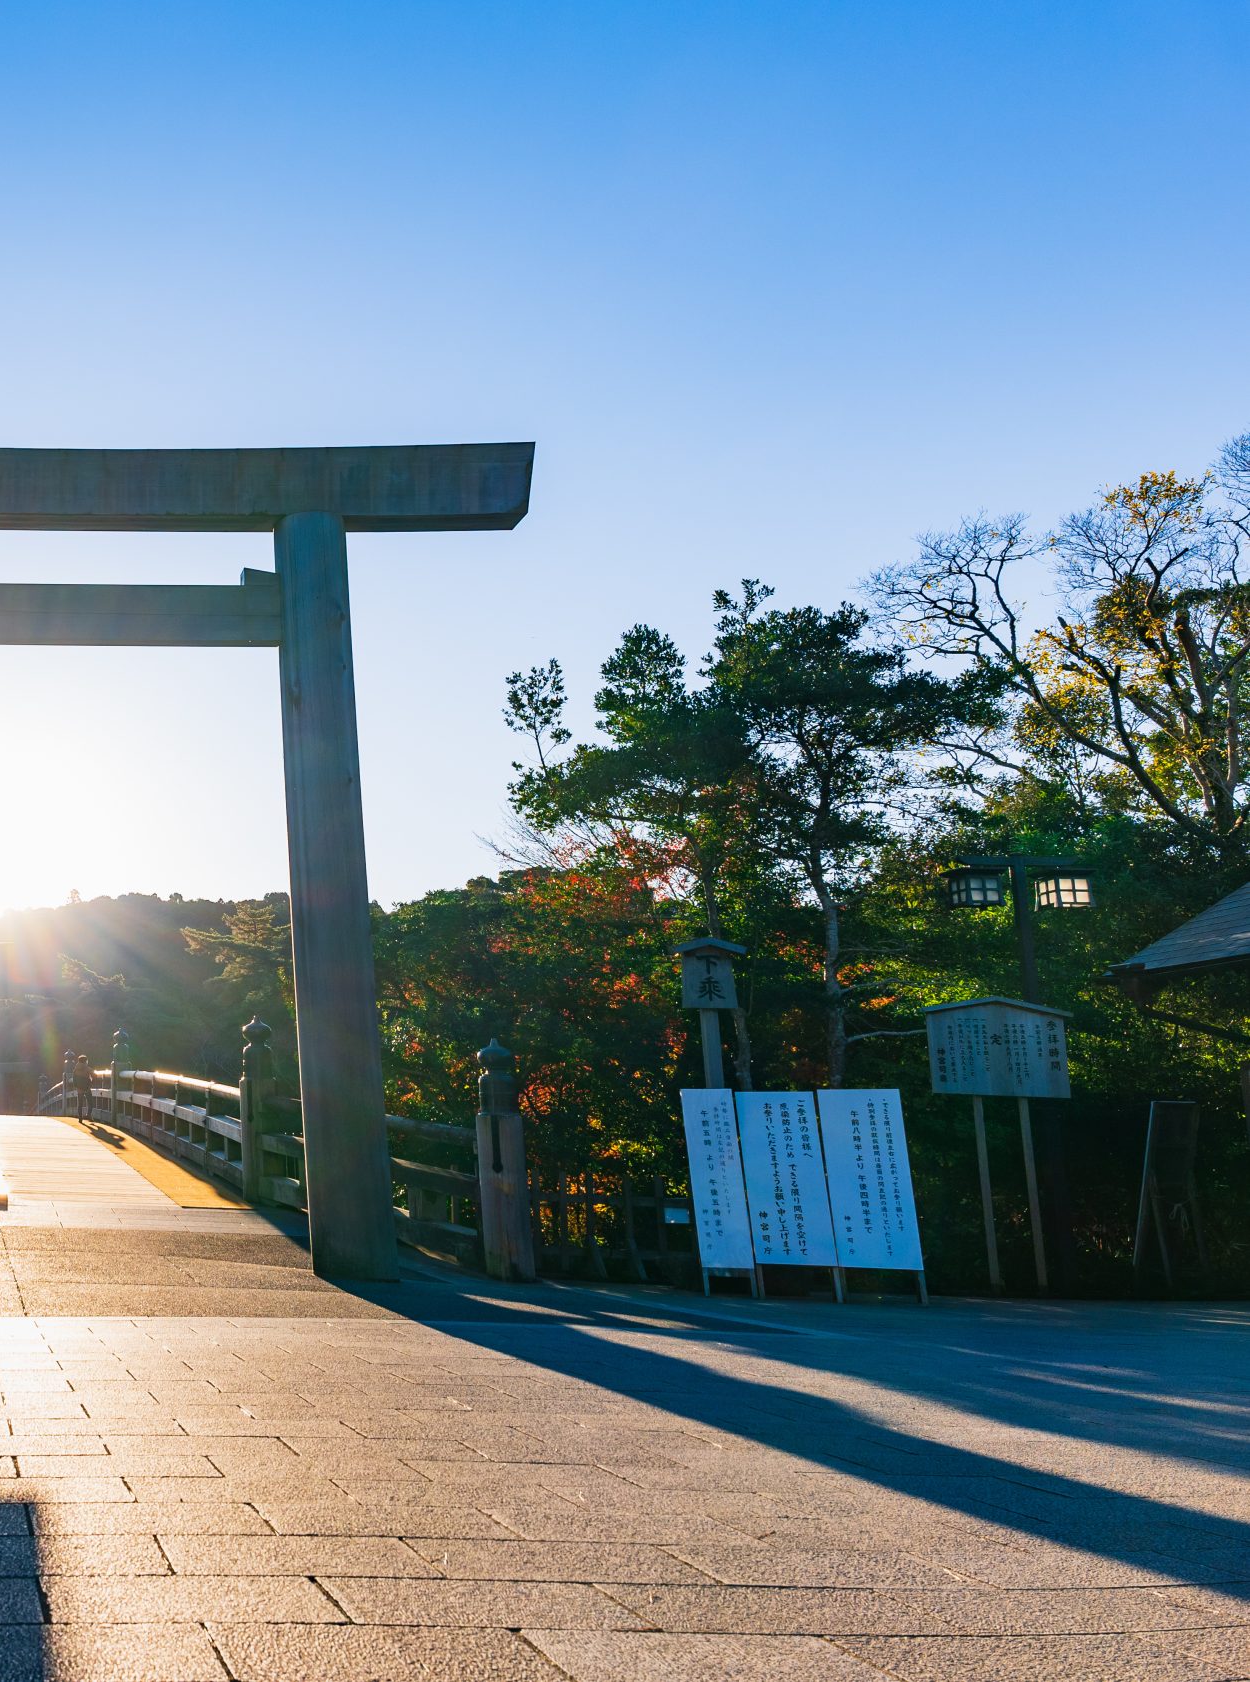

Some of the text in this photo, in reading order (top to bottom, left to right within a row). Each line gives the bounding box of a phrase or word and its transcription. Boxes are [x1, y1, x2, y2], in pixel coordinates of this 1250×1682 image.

[695, 953, 727, 1003] 下乗
[989, 1033, 1003, 1046] 定
[1045, 1019, 1062, 1072] 参拝時間
[796, 1099, 814, 1159] ご参拝の皆様へ
[758, 1210, 774, 1256] 神宮司庁
